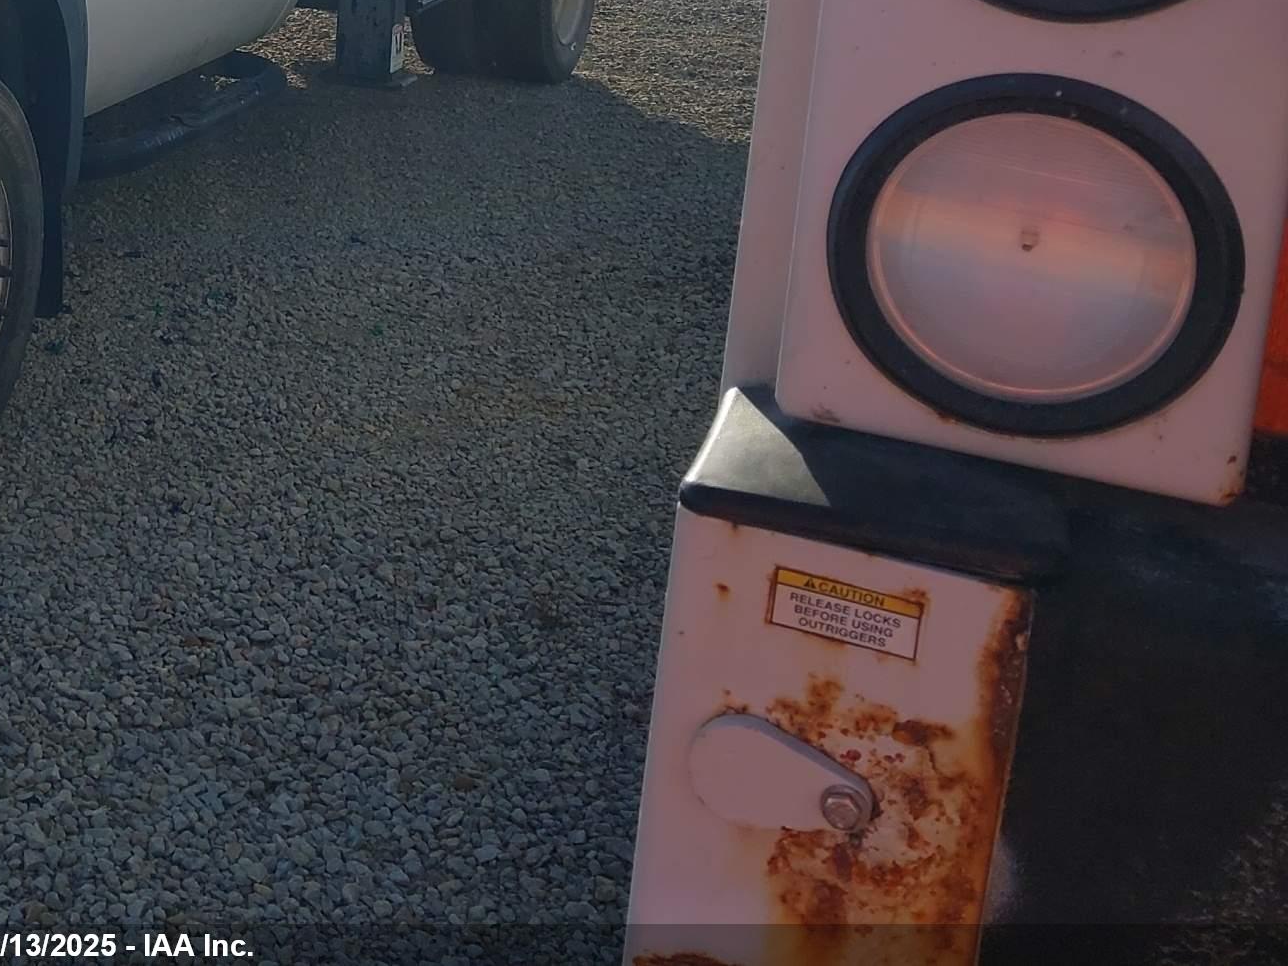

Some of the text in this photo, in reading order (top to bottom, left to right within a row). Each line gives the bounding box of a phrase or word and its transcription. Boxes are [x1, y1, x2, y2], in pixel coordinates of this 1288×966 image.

[789, 591, 901, 629] RELEASE LOCKS
[817, 581, 886, 607] CAUTION
[794, 604, 894, 638] BEFORE USING
[798, 617, 887, 648] OUTRIGGERS
